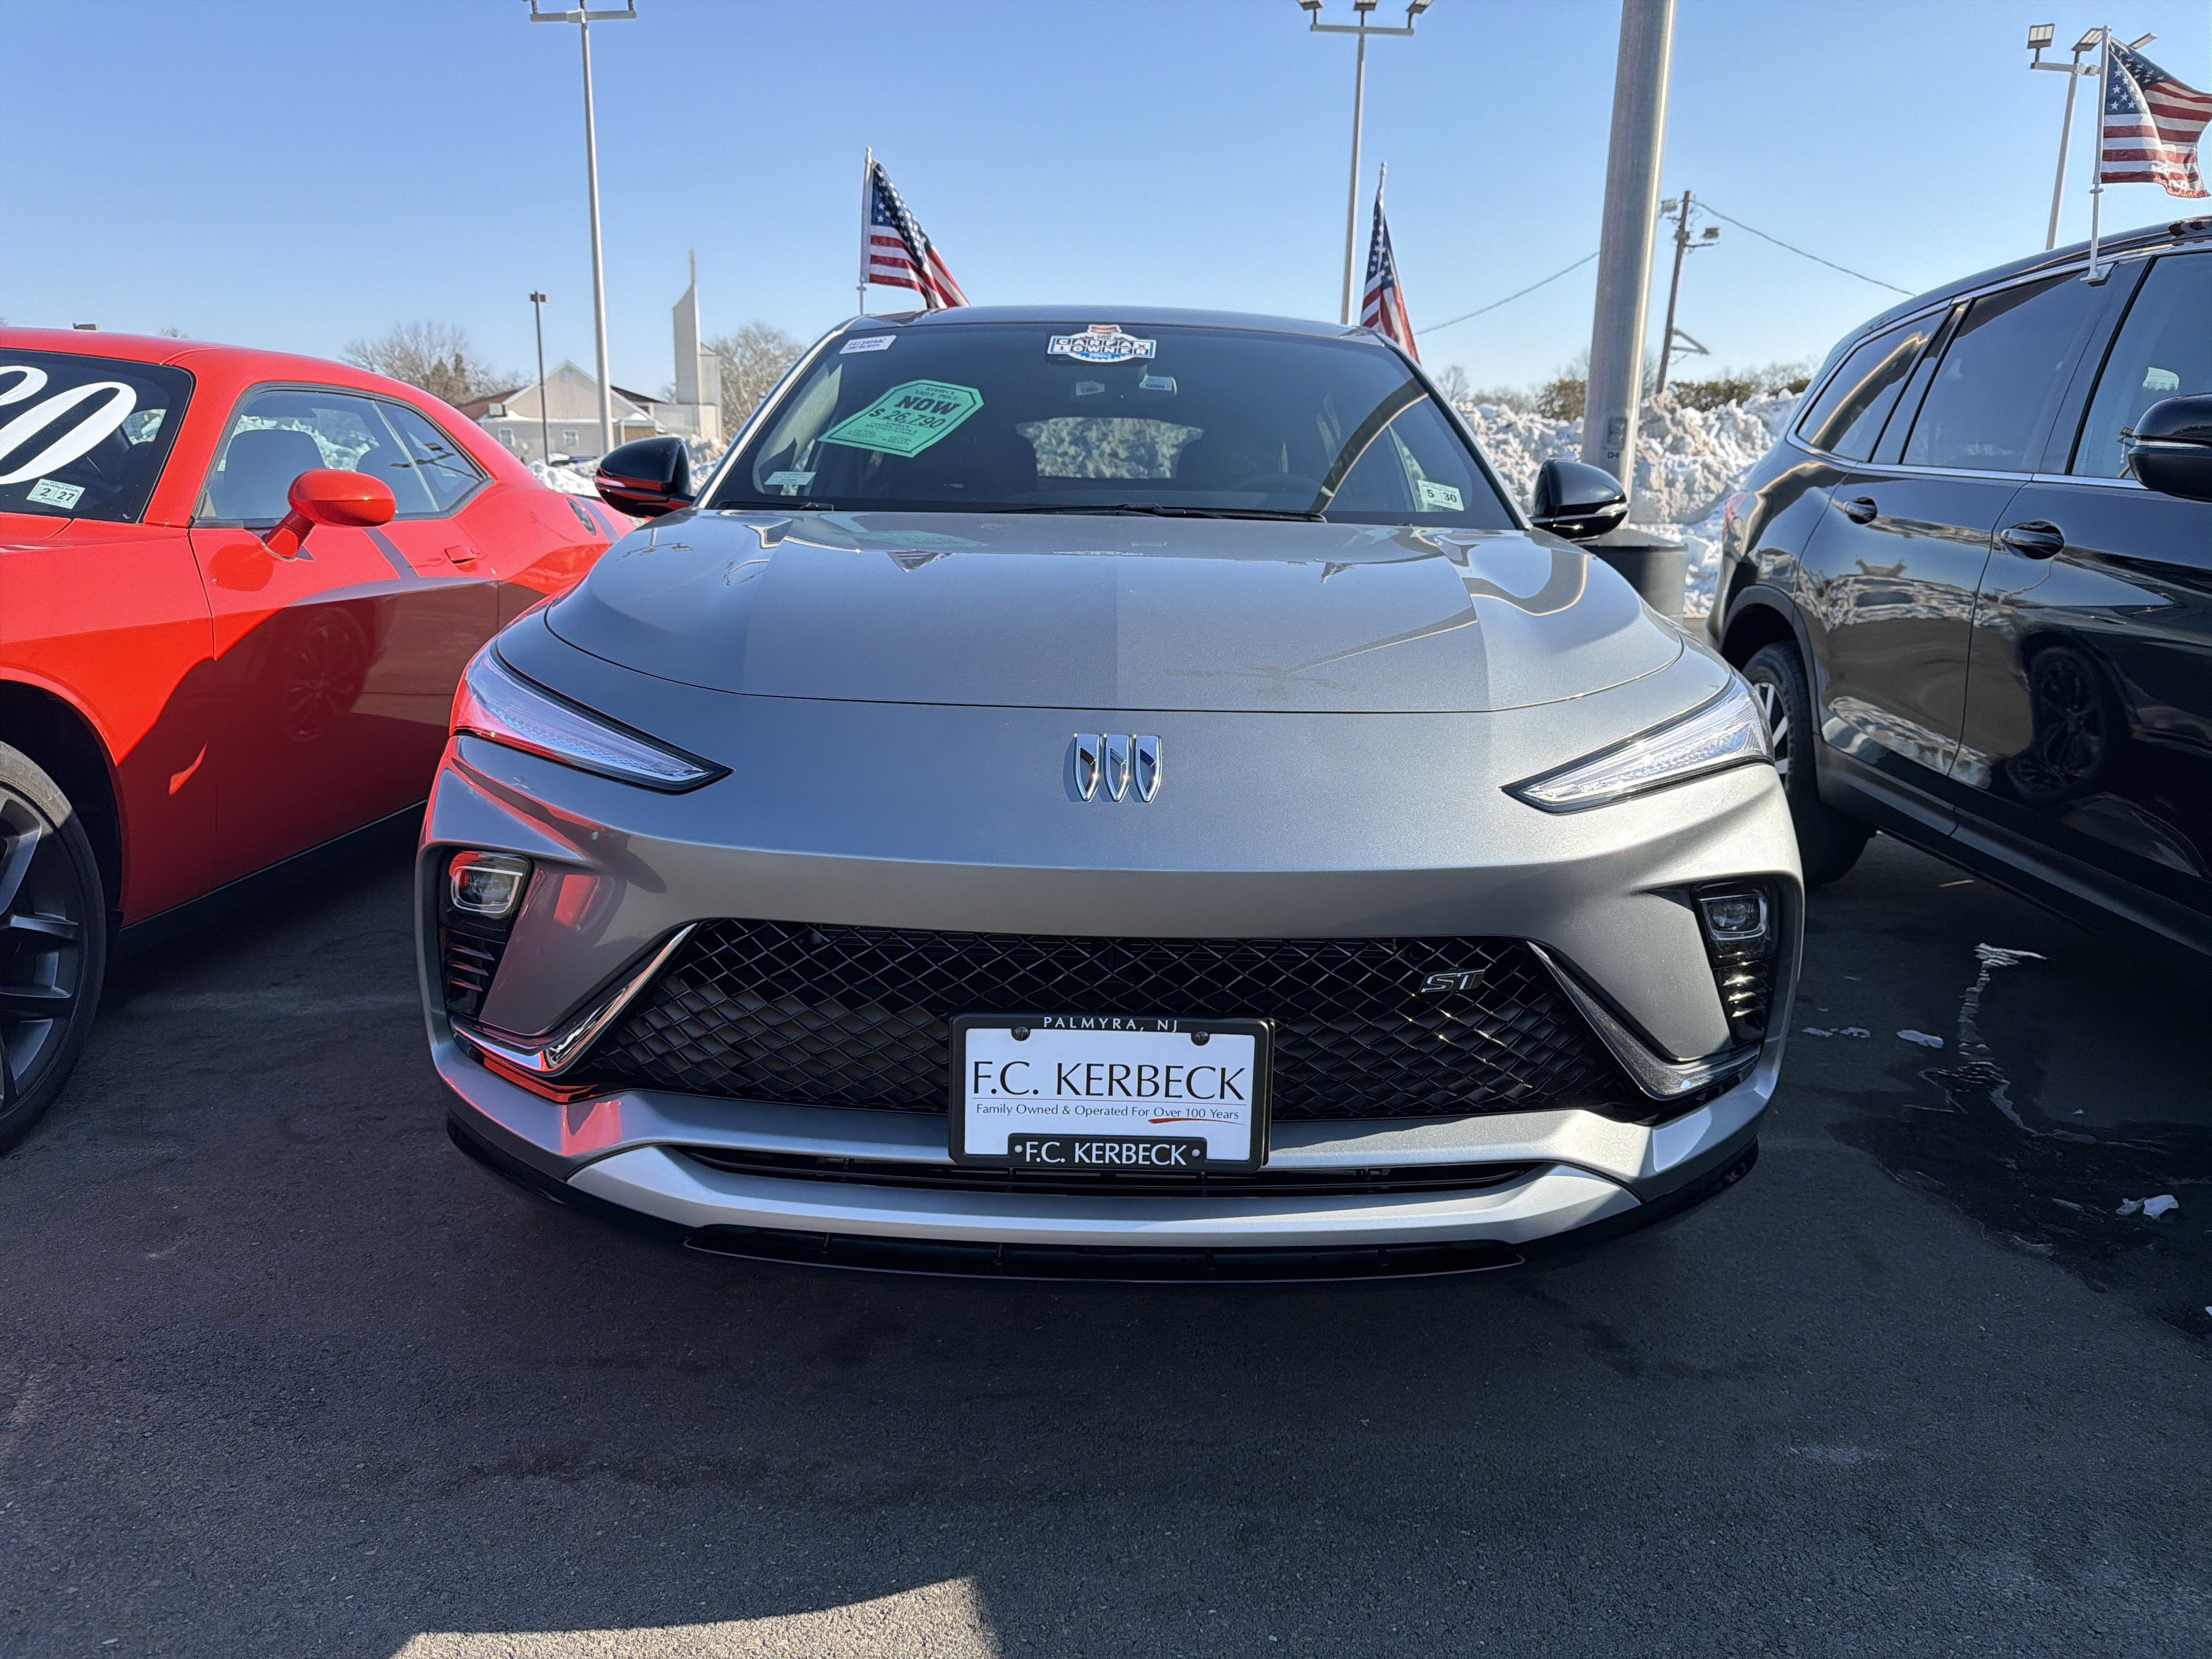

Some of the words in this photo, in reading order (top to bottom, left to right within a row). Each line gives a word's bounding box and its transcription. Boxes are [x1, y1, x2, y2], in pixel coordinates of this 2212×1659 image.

[1058, 338, 1147, 349] CARFAX
[1073, 346, 1146, 355] OWNER
[894, 395, 962, 415] NOW
[868, 408, 887, 417] $
[883, 410, 946, 429] 26,790
[39, 488, 51, 496] 2
[57, 491, 76, 501] 27
[1426, 489, 1435, 498] 5
[1442, 492, 1457, 503] 30
[1420, 969, 1486, 993] ST
[1043, 1017, 1144, 1032] PALMYRA,
[1157, 1019, 1177, 1032] NJ
[973, 1061, 1039, 1096] F.C.
[1056, 1062, 1245, 1101] KERBECK
[977, 1103, 1013, 1116] Family
[1016, 1104, 1058, 1115] Owned
[1062, 1105, 1070, 1115] &
[1075, 1105, 1128, 1117] Operated
[1132, 1107, 1150, 1116] For
[1154, 1107, 1182, 1117] Over
[1186, 1108, 1206, 1118] 100
[1210, 1109, 1239, 1119] Years
[1025, 1142, 1065, 1163] F.C.
[1074, 1142, 1187, 1166] KERBECK
